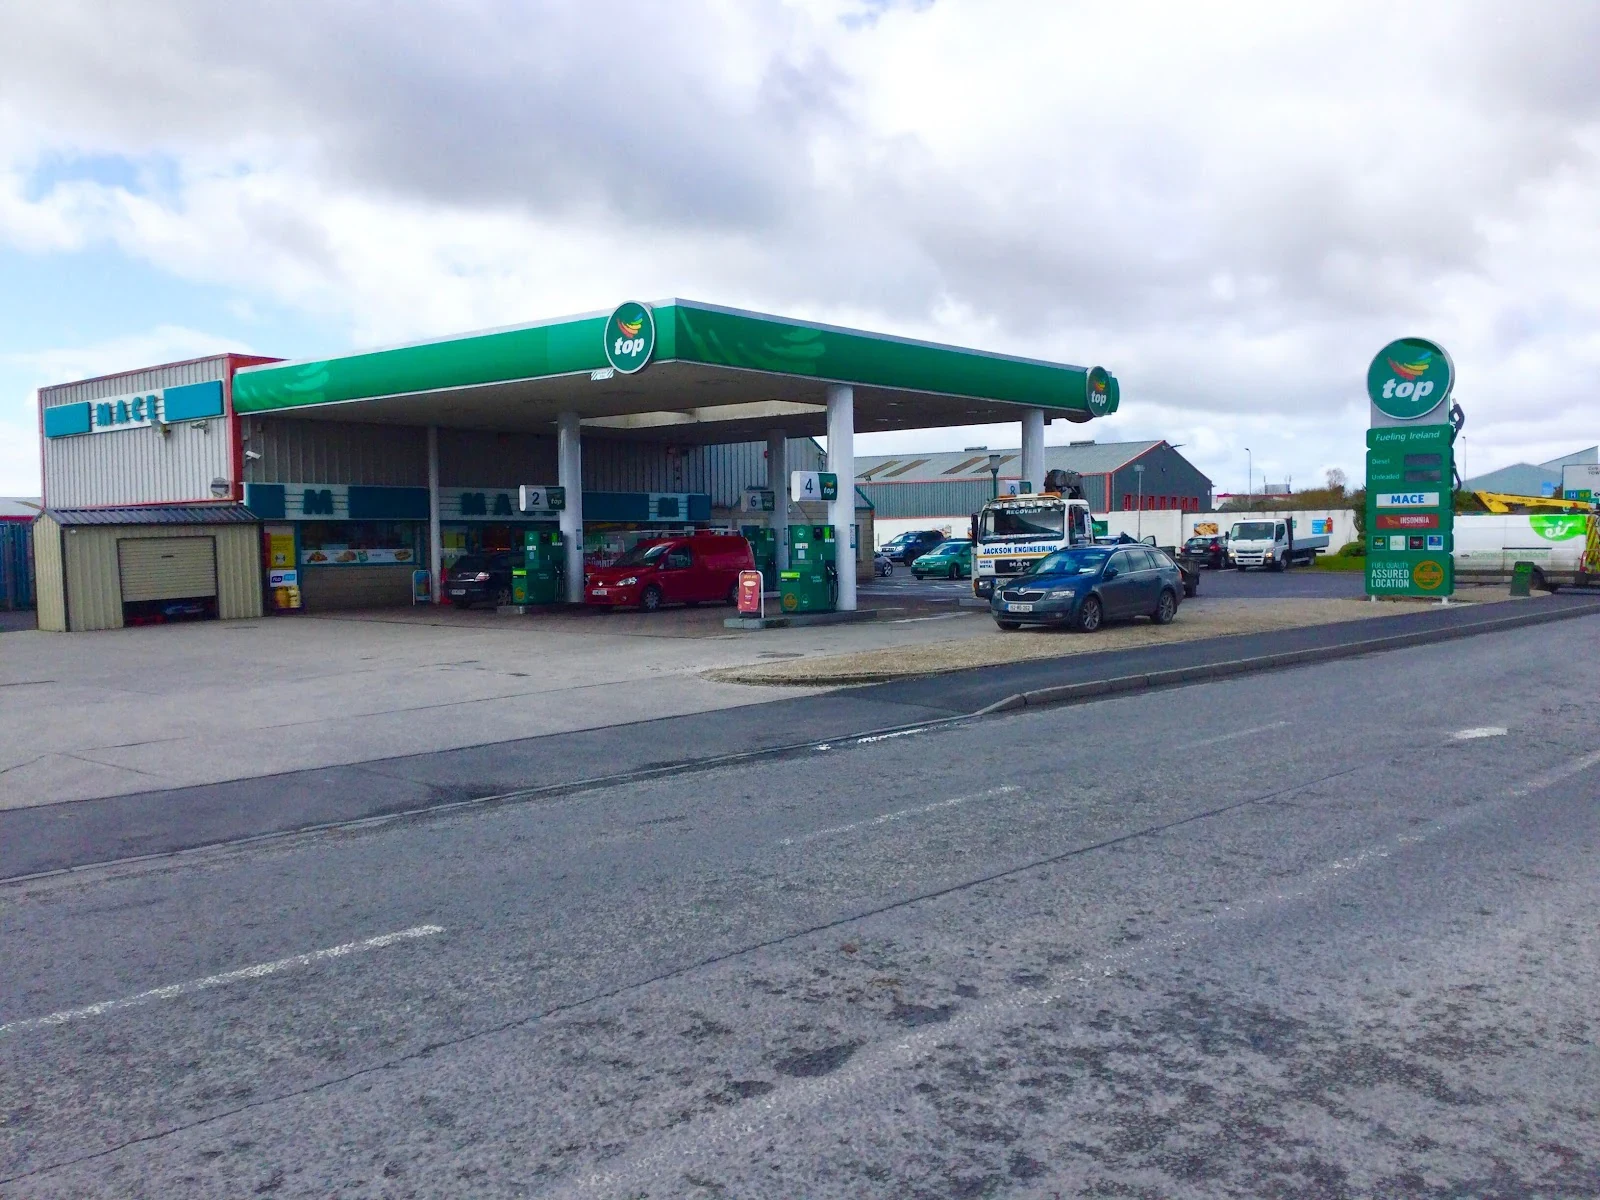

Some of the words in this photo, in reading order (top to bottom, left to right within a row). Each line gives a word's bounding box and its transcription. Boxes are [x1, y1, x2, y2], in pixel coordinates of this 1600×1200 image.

[614, 336, 645, 357] top
[1382, 378, 1435, 402] top
[1090, 390, 1107, 407] top
[96, 394, 158, 426] MACE
[1375, 433, 1406, 442] Fueling
[1409, 431, 1440, 440] Ireland
[1371, 473, 1400, 481] Unleaded
[805, 478, 813, 494] 4
[823, 487, 834, 495] top
[532, 491, 540, 505] 2
[551, 498, 562, 506] top
[750, 495, 757, 507] 6
[1391, 494, 1425, 504] MACE
[1399, 516, 1430, 525] INSOMNIA
[1544, 520, 1574, 538] eir
[983, 547, 1012, 555] JACKSON
[1014, 545, 1058, 553] ENGINEERING
[1386, 561, 1409, 569] QUALITY
[1371, 569, 1410, 579] ASSURED
[1371, 578, 1410, 588] LOCATION
